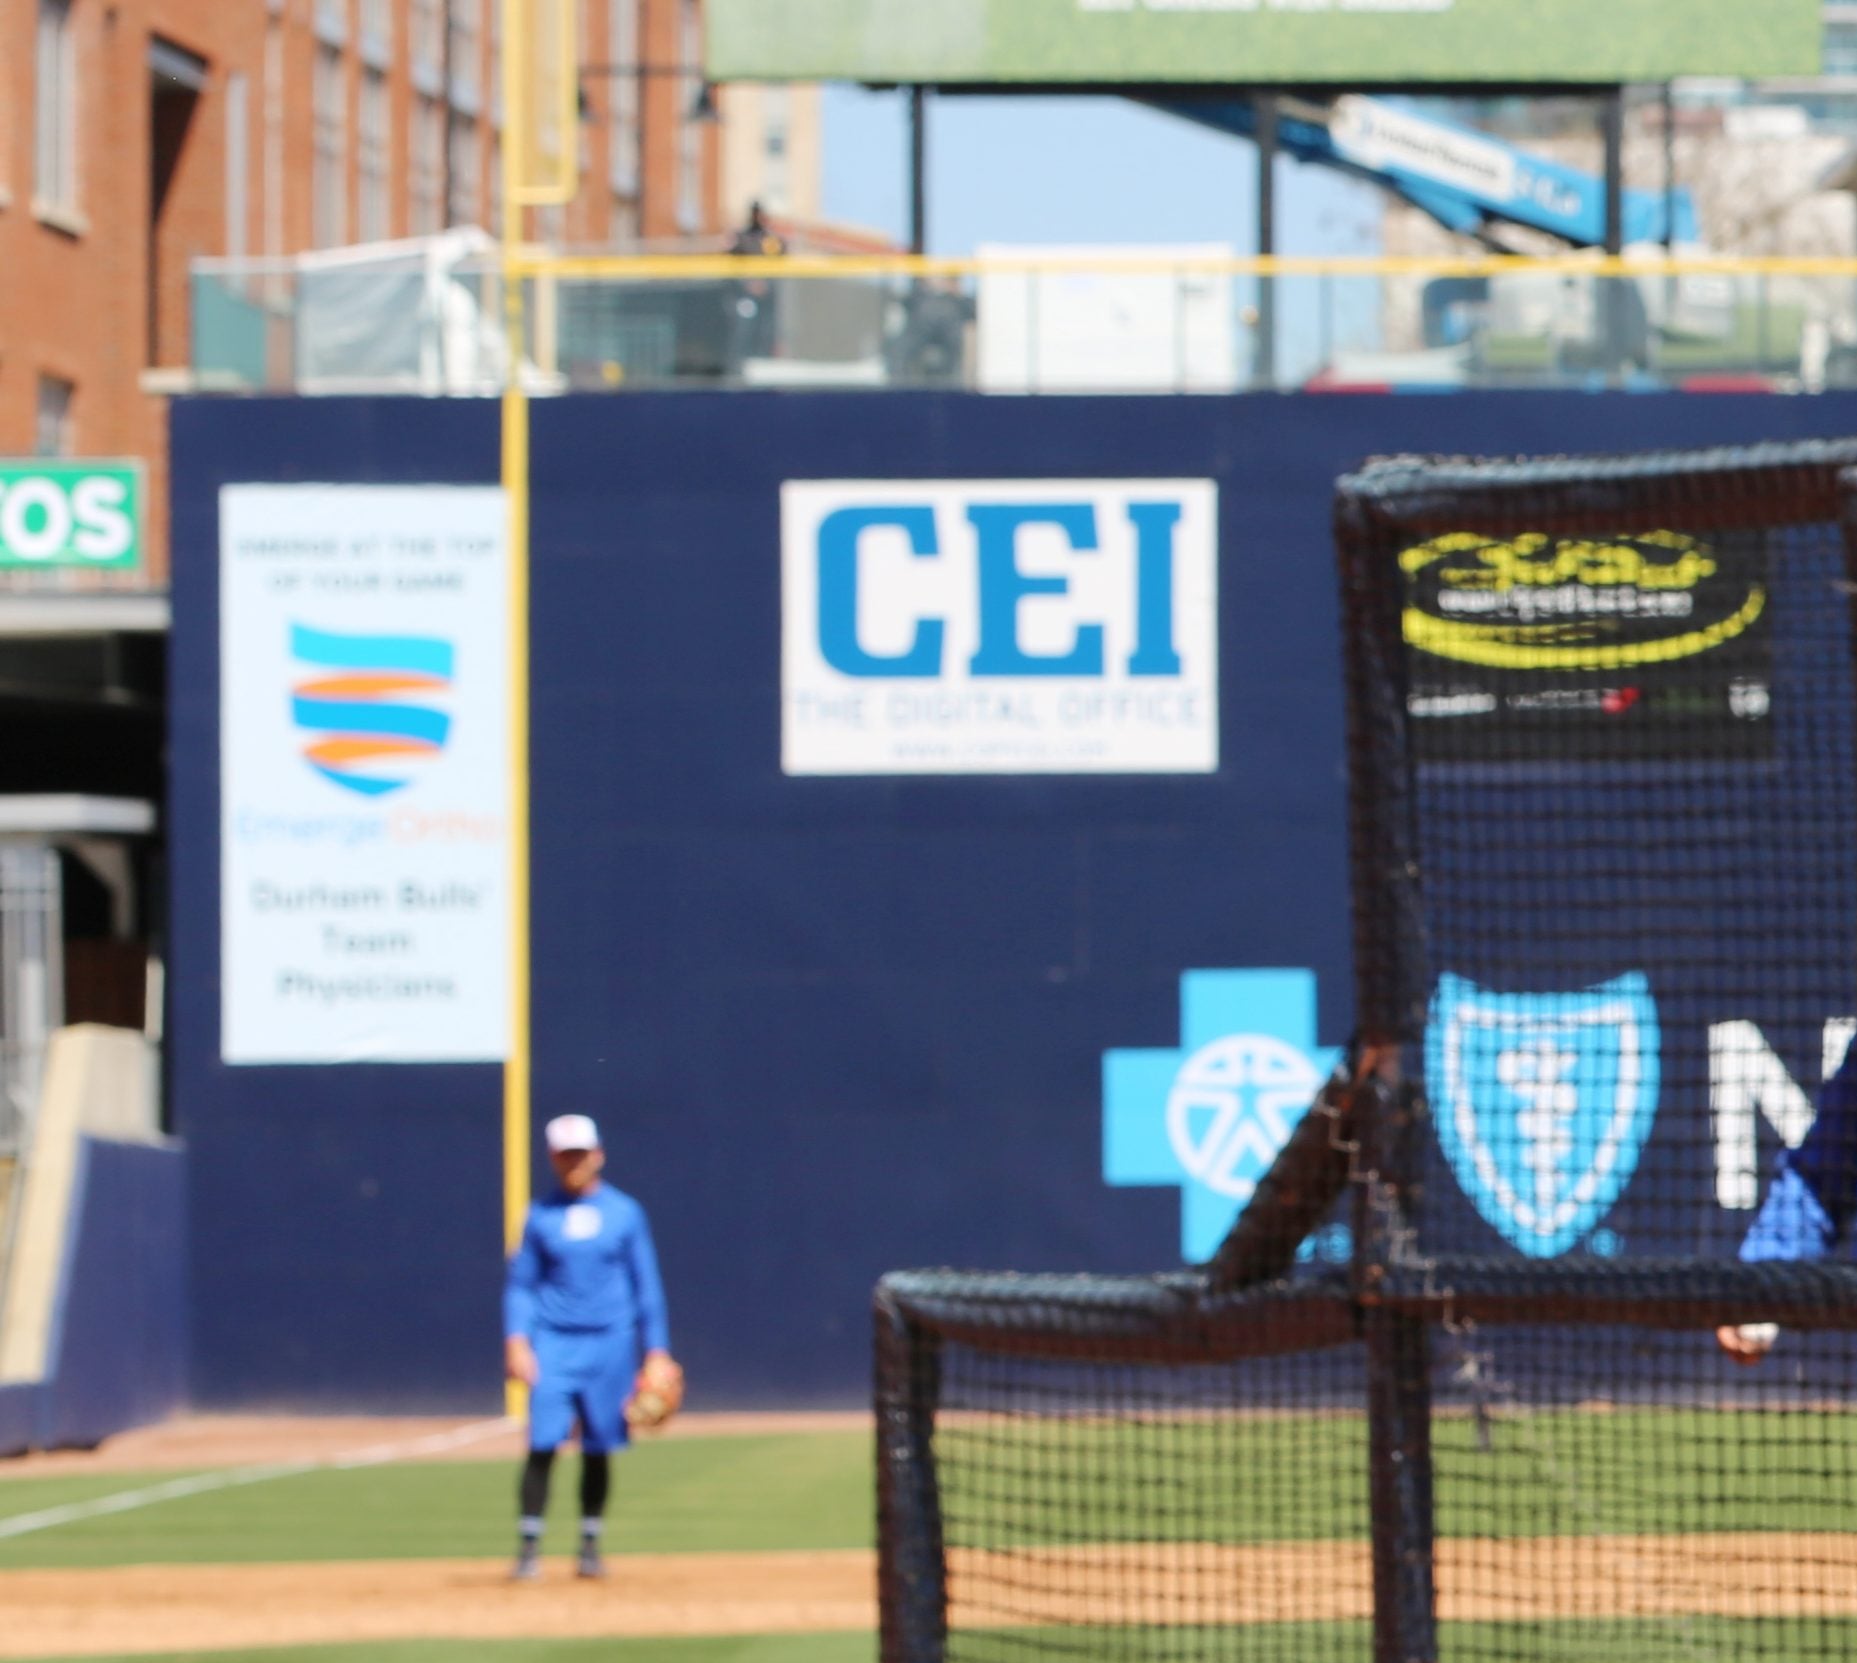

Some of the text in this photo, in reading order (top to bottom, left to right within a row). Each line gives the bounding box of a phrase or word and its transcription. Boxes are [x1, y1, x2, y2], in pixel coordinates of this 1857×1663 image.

[0, 476, 133, 561] OS
[817, 503, 1182, 677] CEI
[794, 688, 1203, 729] THE DIGITAL OFFICE
